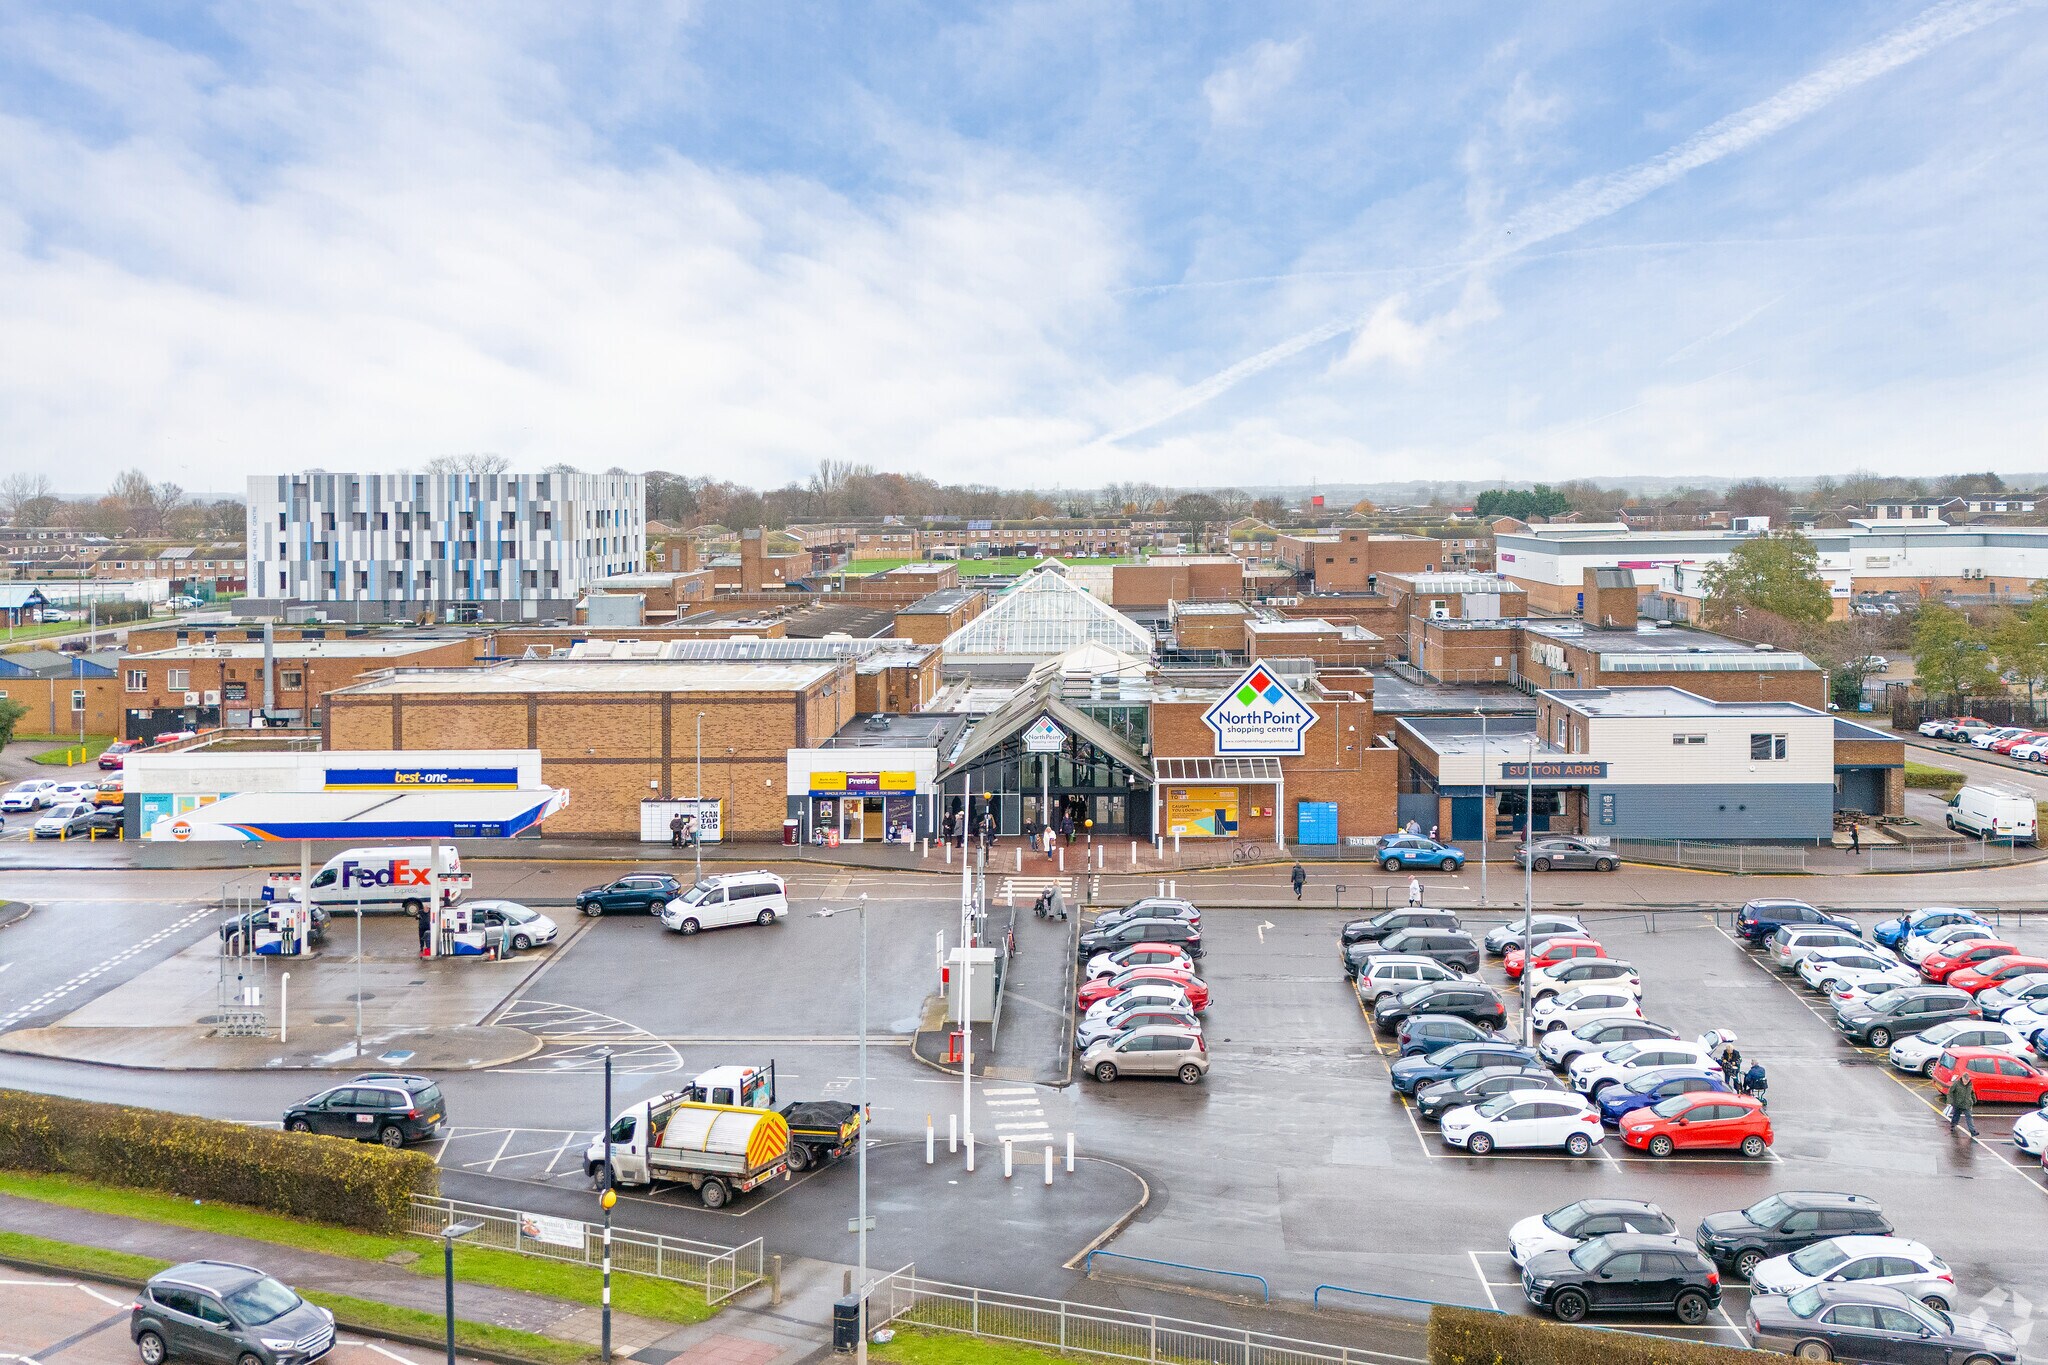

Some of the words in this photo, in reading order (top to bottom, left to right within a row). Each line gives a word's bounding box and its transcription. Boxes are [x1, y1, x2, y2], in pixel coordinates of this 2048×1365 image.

[1219, 710, 1261, 725] North
[1263, 710, 1302, 725] Point
[1227, 725, 1265, 734] shopping
[1565, 765, 1601, 775] ARMS
[394, 771, 448, 784] best-one
[848, 777, 878, 785] Premier
[1349, 837, 1363, 846] TAXI
[343, 859, 432, 888] FedEx
[394, 887, 418, 895] Express
